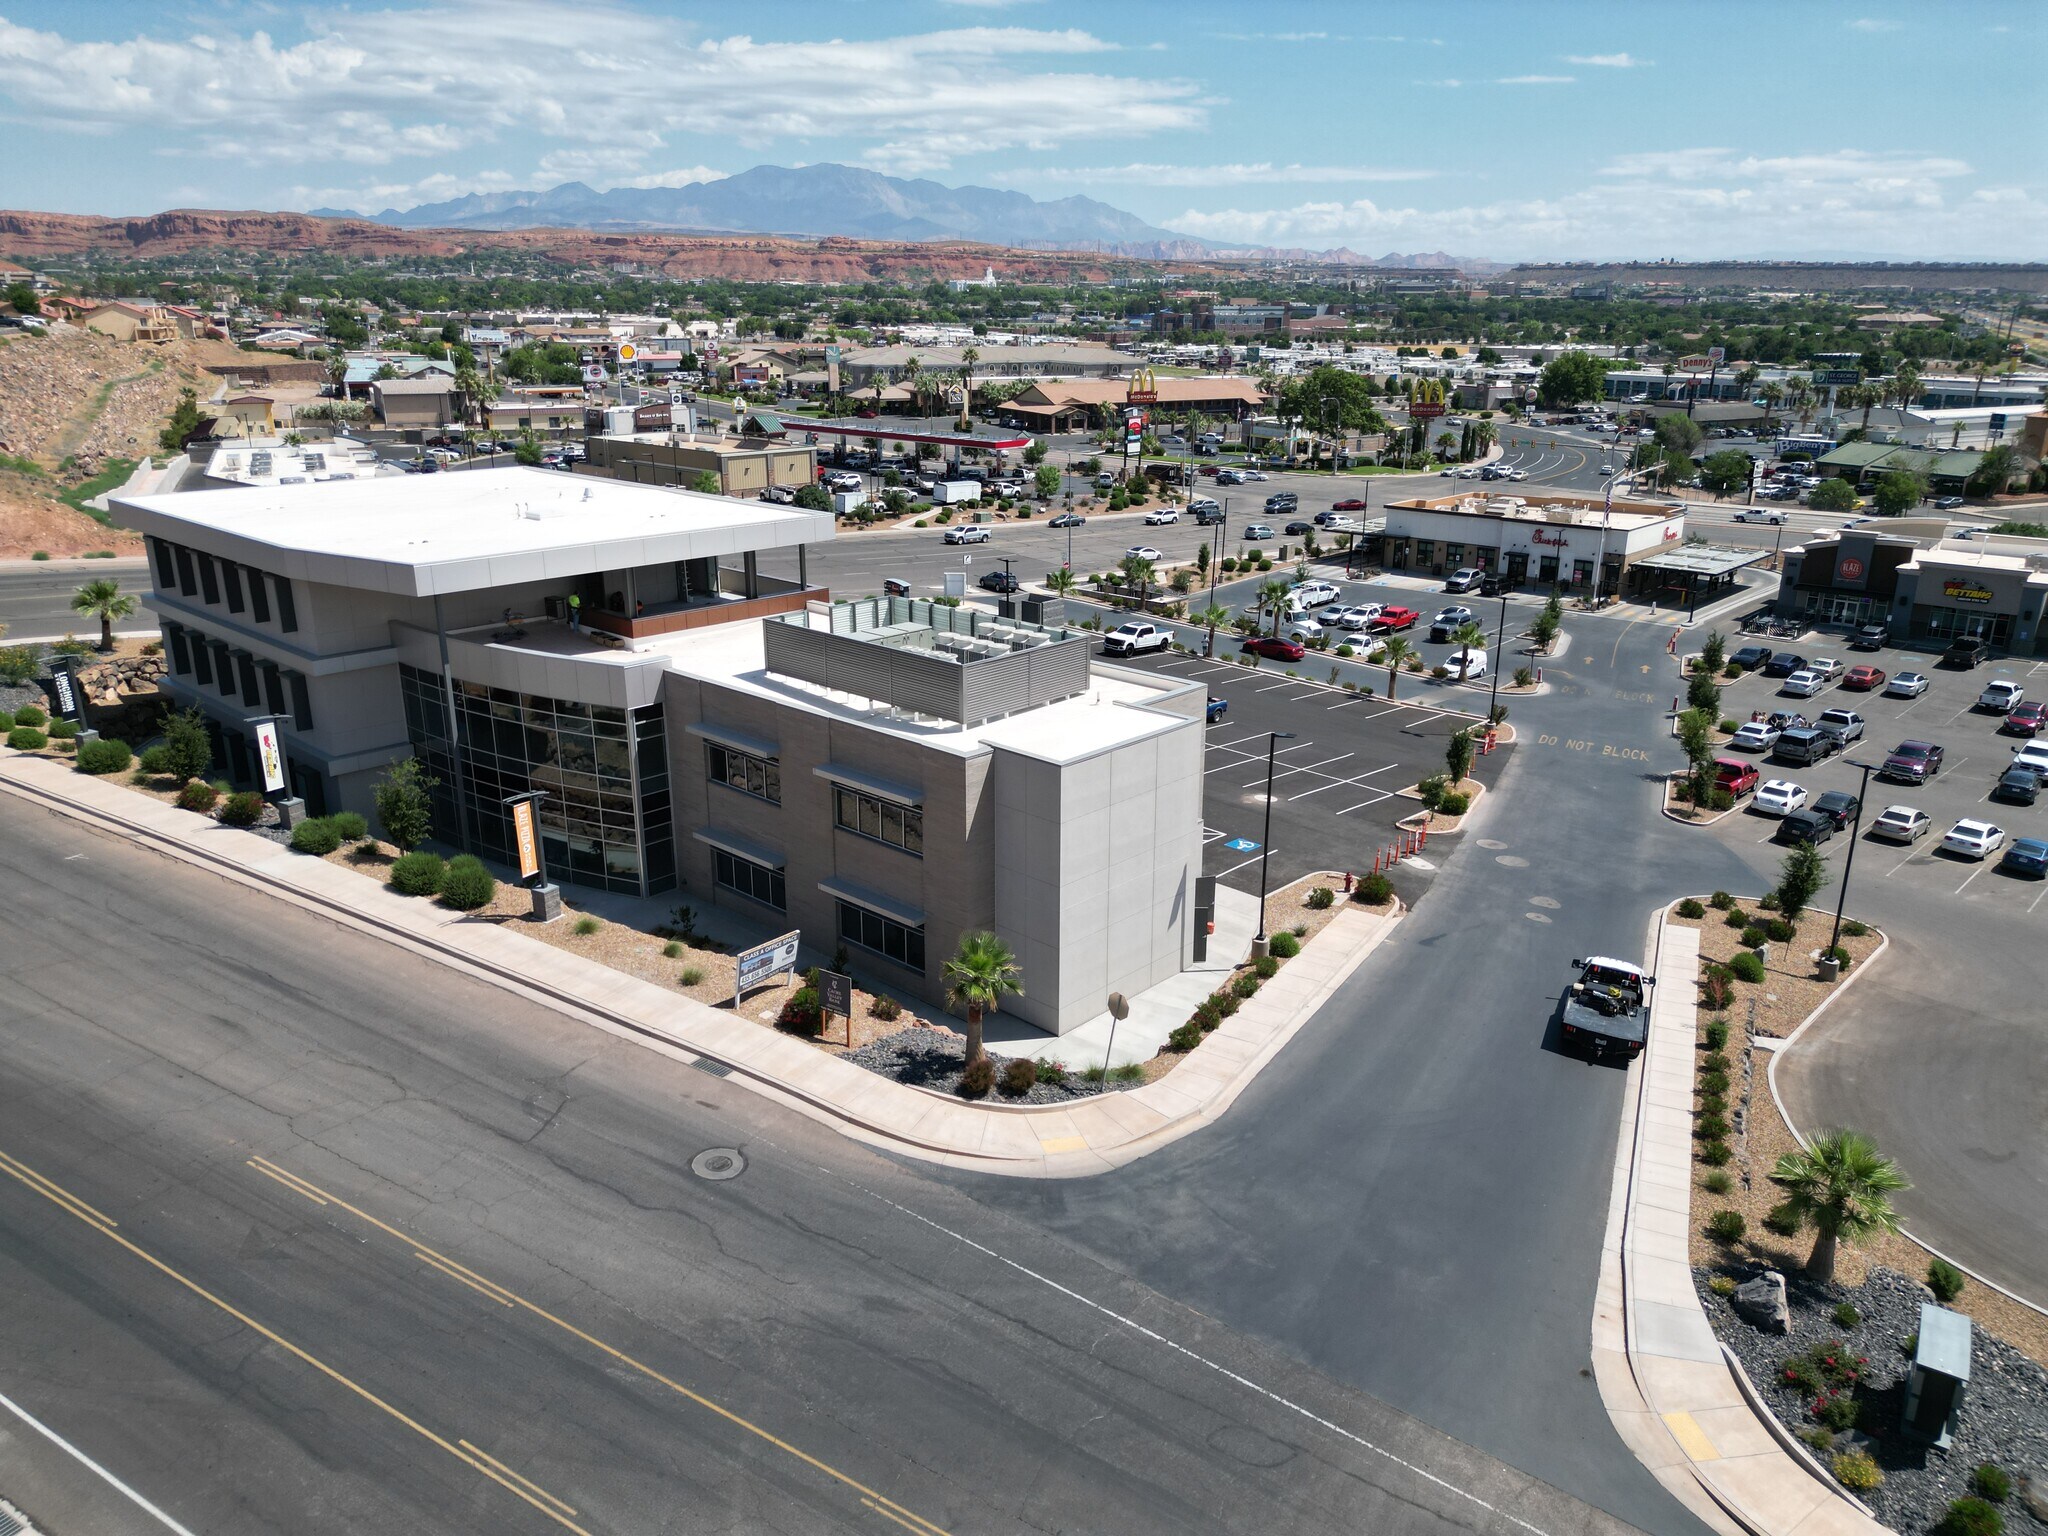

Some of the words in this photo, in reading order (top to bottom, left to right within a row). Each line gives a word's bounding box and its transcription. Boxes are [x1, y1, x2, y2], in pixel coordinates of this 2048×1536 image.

[1683, 358, 1713, 368] Denny's
[58, 671, 75, 711] LONGHORN
[1538, 734, 1558, 746] DO
[1565, 740, 1594, 752] NOT
[1602, 744, 1650, 762] BLOCK
[744, 950, 760, 960] CLASS
[764, 941, 782, 952] OFFICE
[782, 934, 798, 944] SPACE
